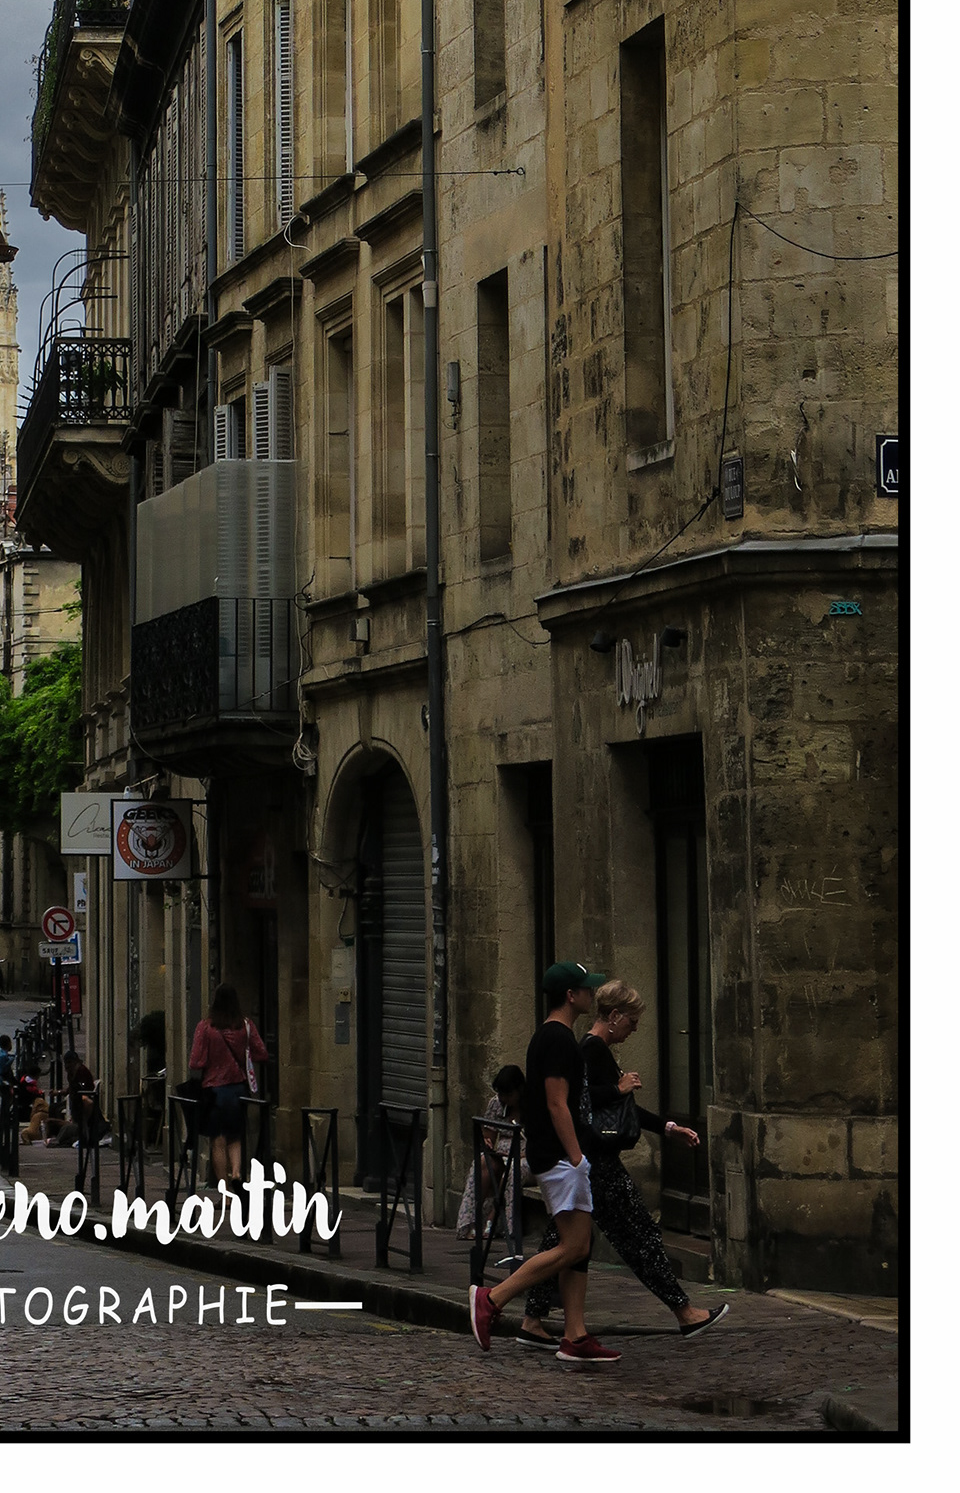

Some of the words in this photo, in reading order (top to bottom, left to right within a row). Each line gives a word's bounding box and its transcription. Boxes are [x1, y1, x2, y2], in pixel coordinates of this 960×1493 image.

[886, 469, 899, 484] A
[129, 860, 141, 869] IN
[143, 859, 174, 869] JAPAN
